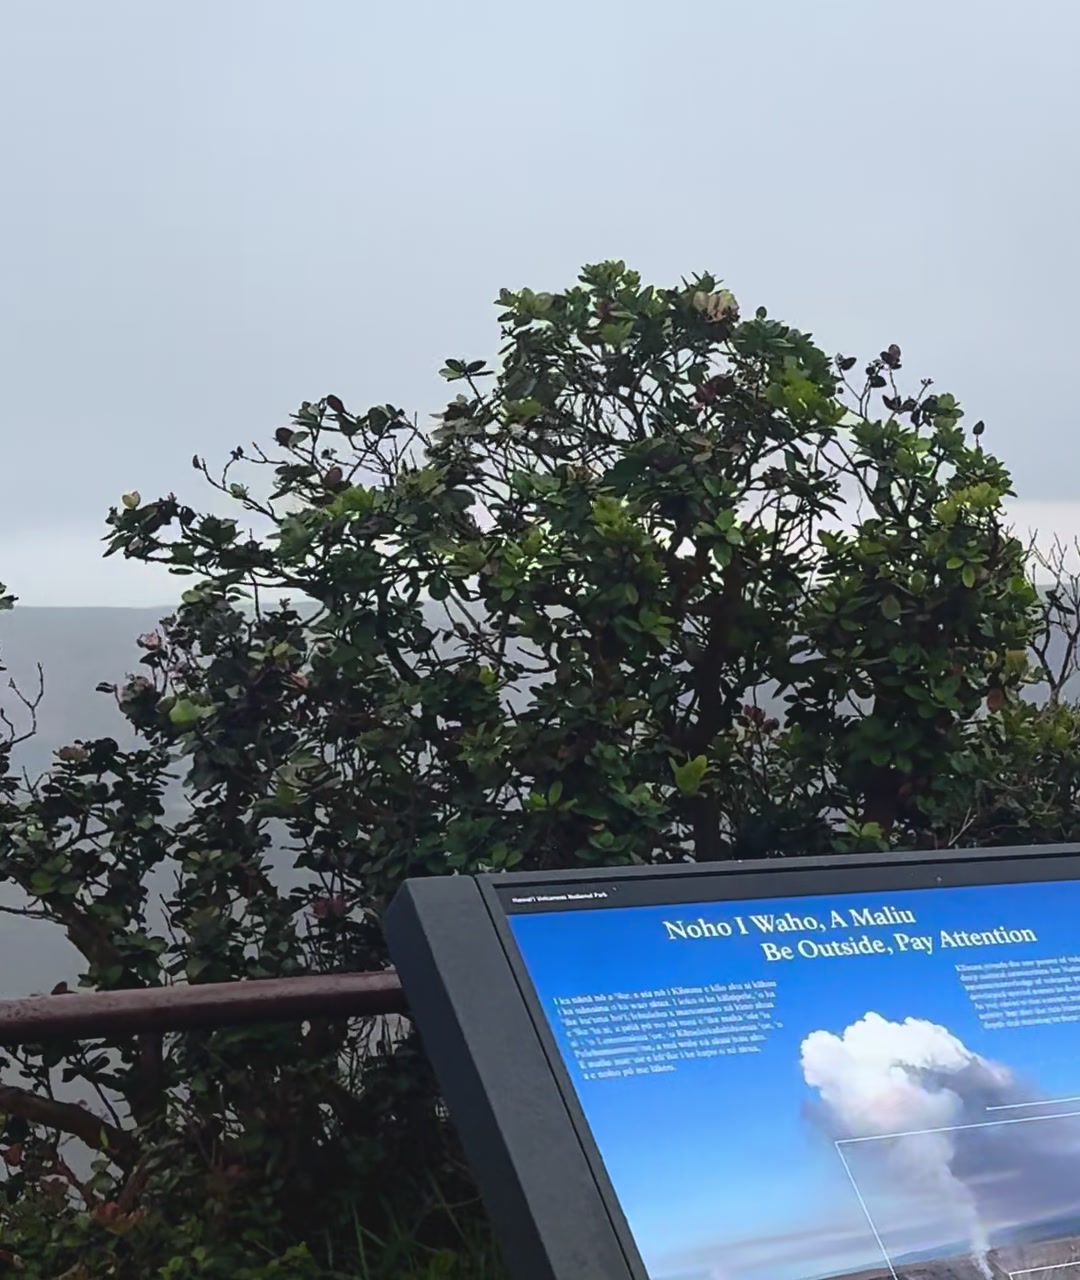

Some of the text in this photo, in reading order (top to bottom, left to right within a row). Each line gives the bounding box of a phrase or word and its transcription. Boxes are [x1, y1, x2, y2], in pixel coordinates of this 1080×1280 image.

[593, 891, 608, 899] Park
[662, 906, 917, 940] Noho I Waho, A Maliu
[760, 926, 1039, 962] Be Outside, Pay Attention
